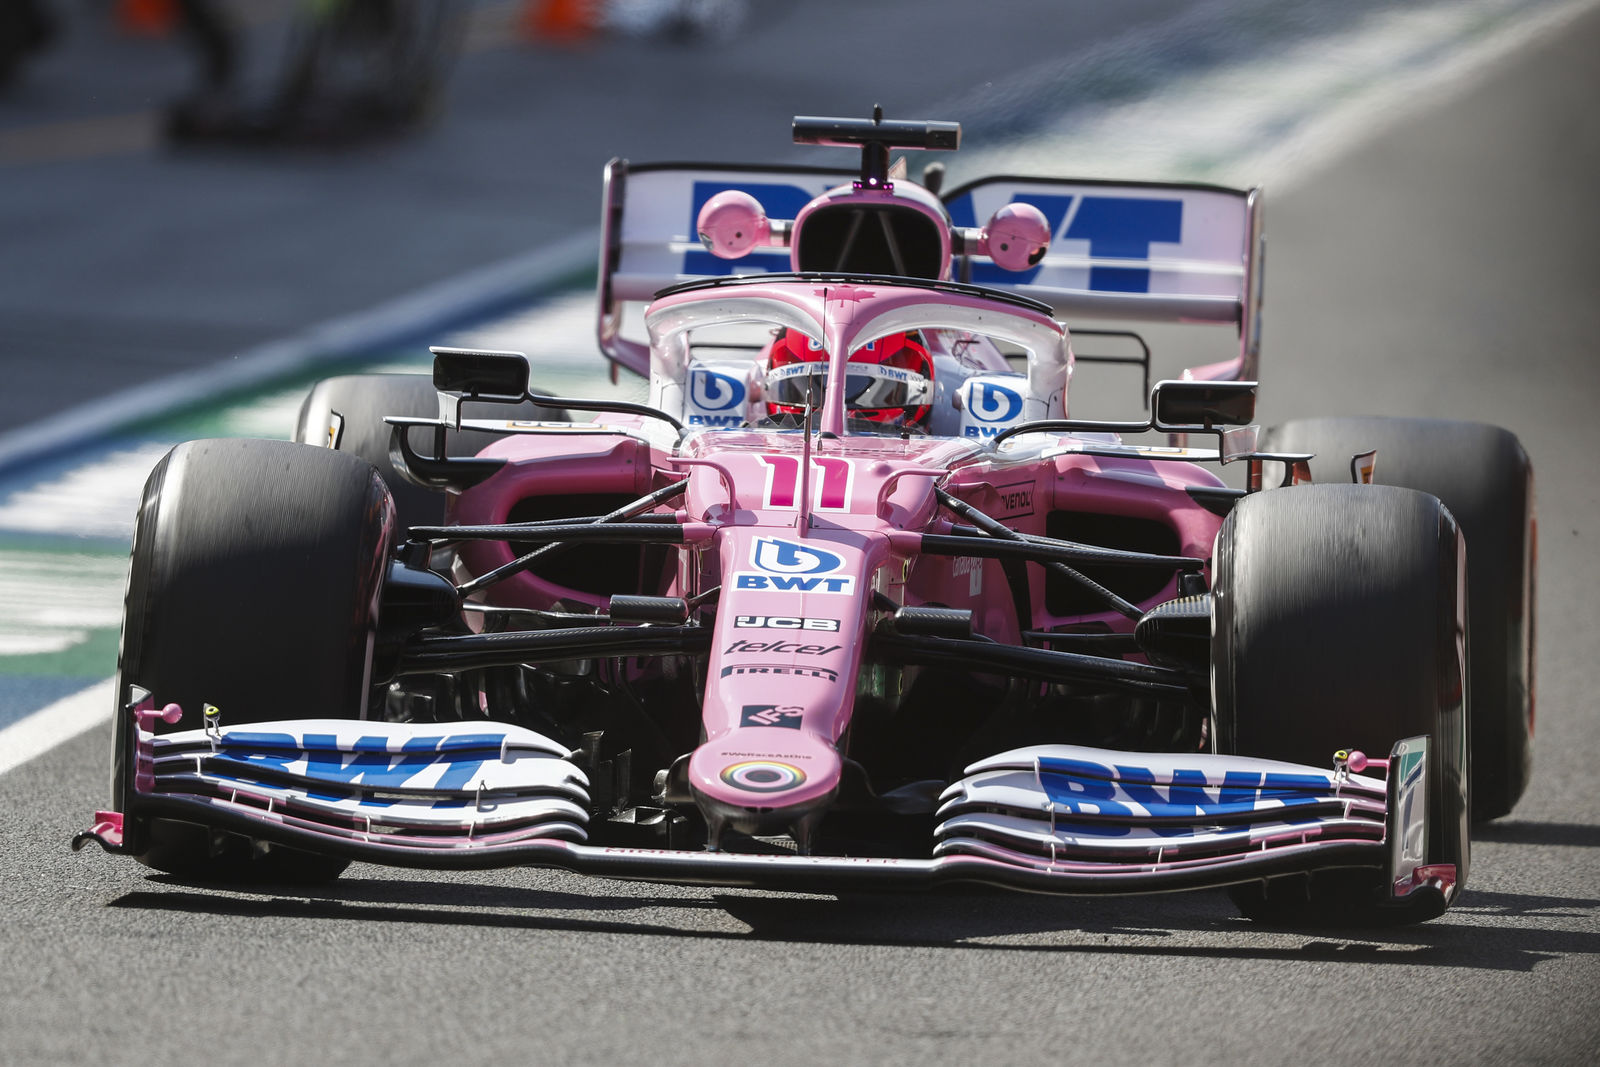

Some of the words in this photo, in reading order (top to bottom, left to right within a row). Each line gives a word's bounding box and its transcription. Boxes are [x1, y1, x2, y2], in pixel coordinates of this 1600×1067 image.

[689, 415, 744, 427] BWT
[965, 426, 1016, 439] BW
[753, 453, 856, 514] 11
[736, 575, 850, 593] BWT
[736, 616, 838, 631] JCB
[723, 640, 843, 656] telcel
[720, 664, 839, 683] PIRELLI
[747, 706, 805, 726] IFS
